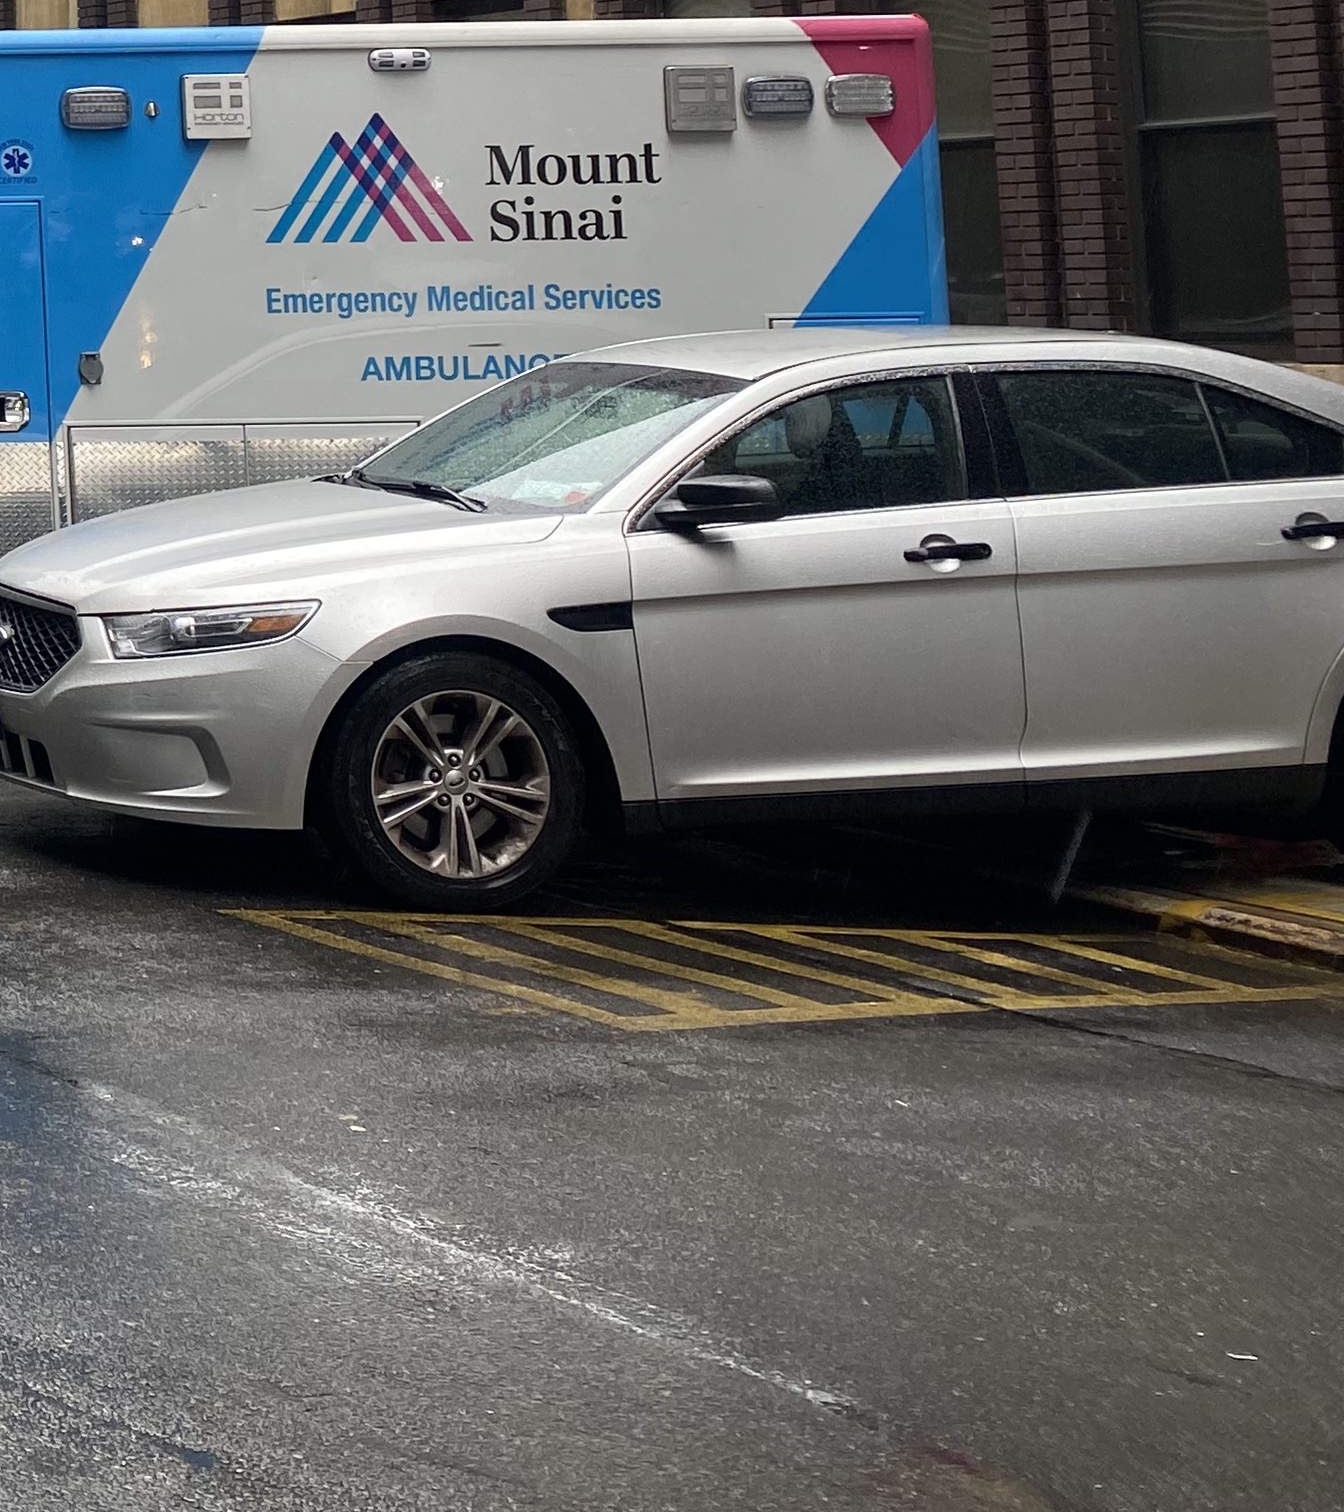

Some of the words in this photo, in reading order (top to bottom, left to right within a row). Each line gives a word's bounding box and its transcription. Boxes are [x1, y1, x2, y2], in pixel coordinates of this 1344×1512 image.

[193, 113, 245, 122] Horton
[484, 142, 662, 186] Mount
[490, 195, 628, 242] Sinai
[266, 287, 418, 319] Emergency
[427, 284, 535, 312] Medical
[544, 283, 662, 310] Services
[361, 353, 569, 382] AMBULANC
